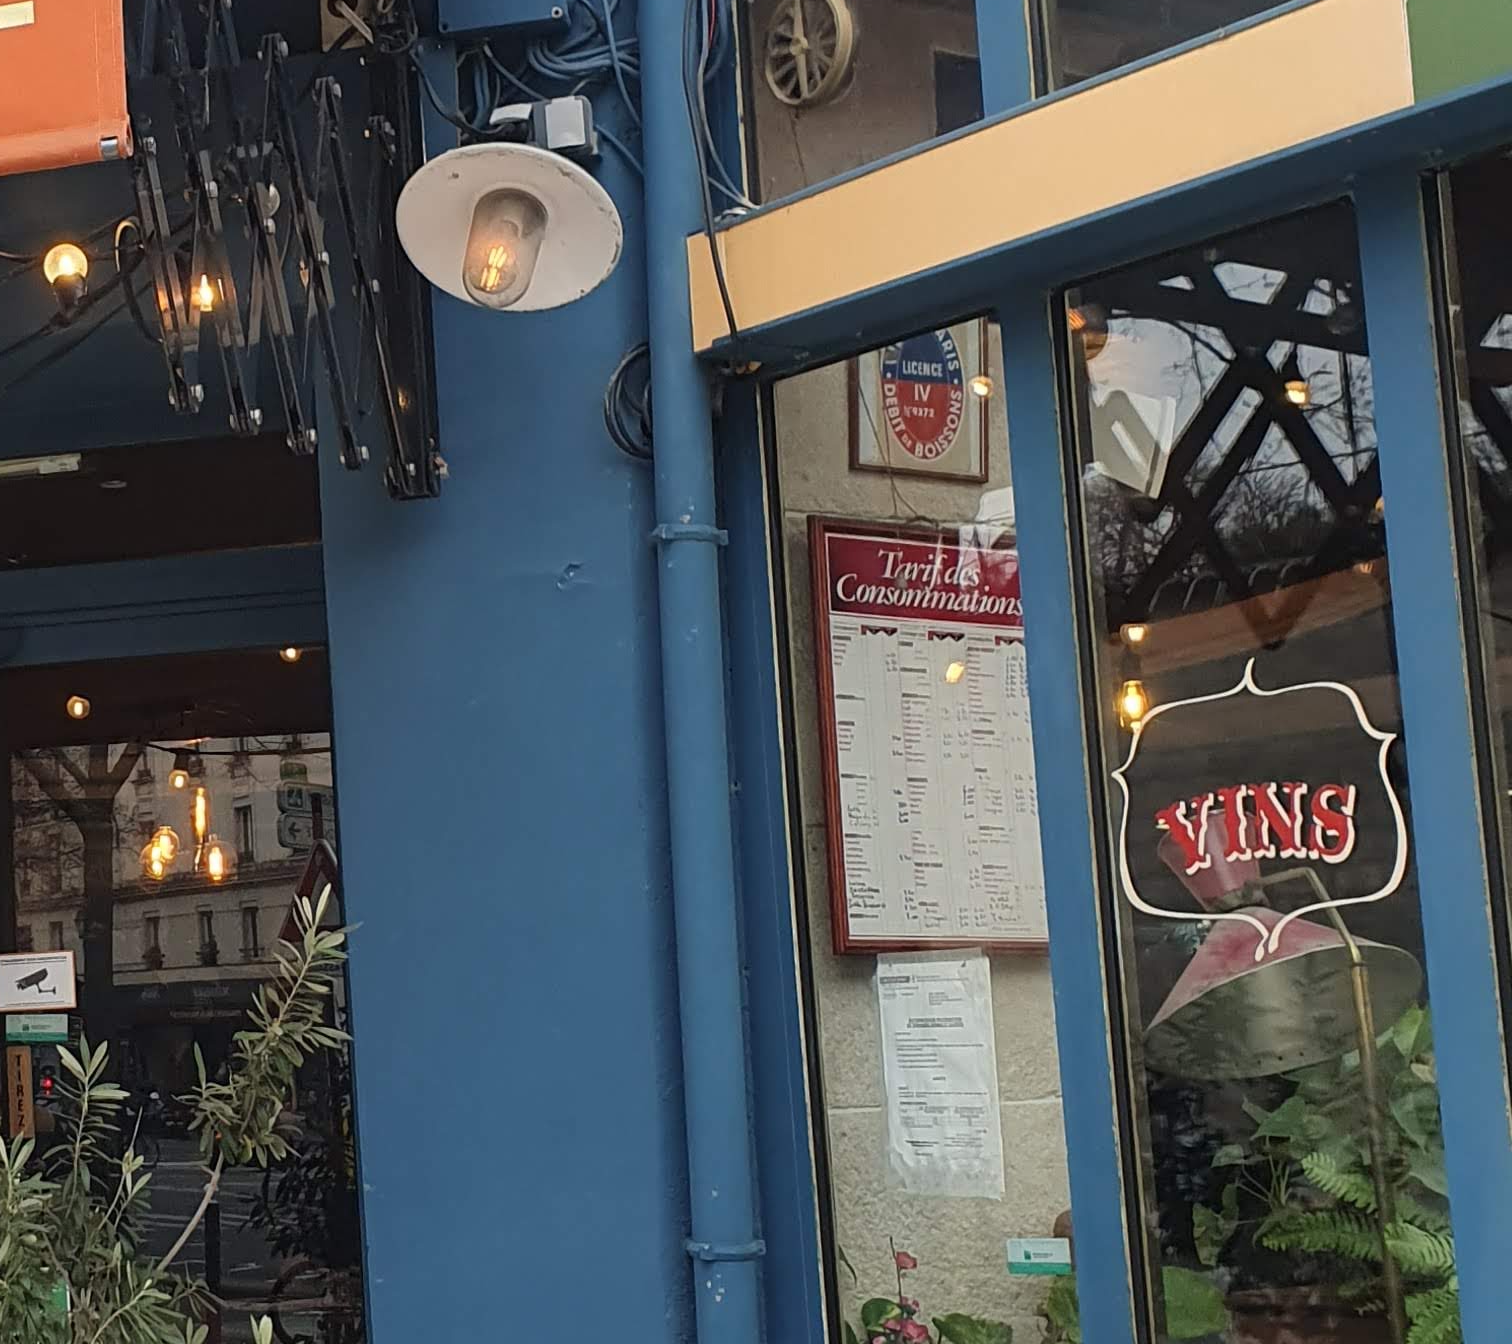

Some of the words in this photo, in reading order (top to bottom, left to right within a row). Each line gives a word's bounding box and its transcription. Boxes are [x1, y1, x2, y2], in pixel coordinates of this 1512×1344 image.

[902, 359, 944, 377] LICENCE
[935, 329, 960, 372] ARIS
[914, 384, 931, 402] IV
[915, 389, 963, 458] BOISSONS
[877, 548, 948, 589] Tarif
[944, 560, 981, 588] des
[836, 573, 1024, 617] Consommations
[1155, 782, 1356, 876] VINS
[15, 1055, 26, 1128] TIREZ
